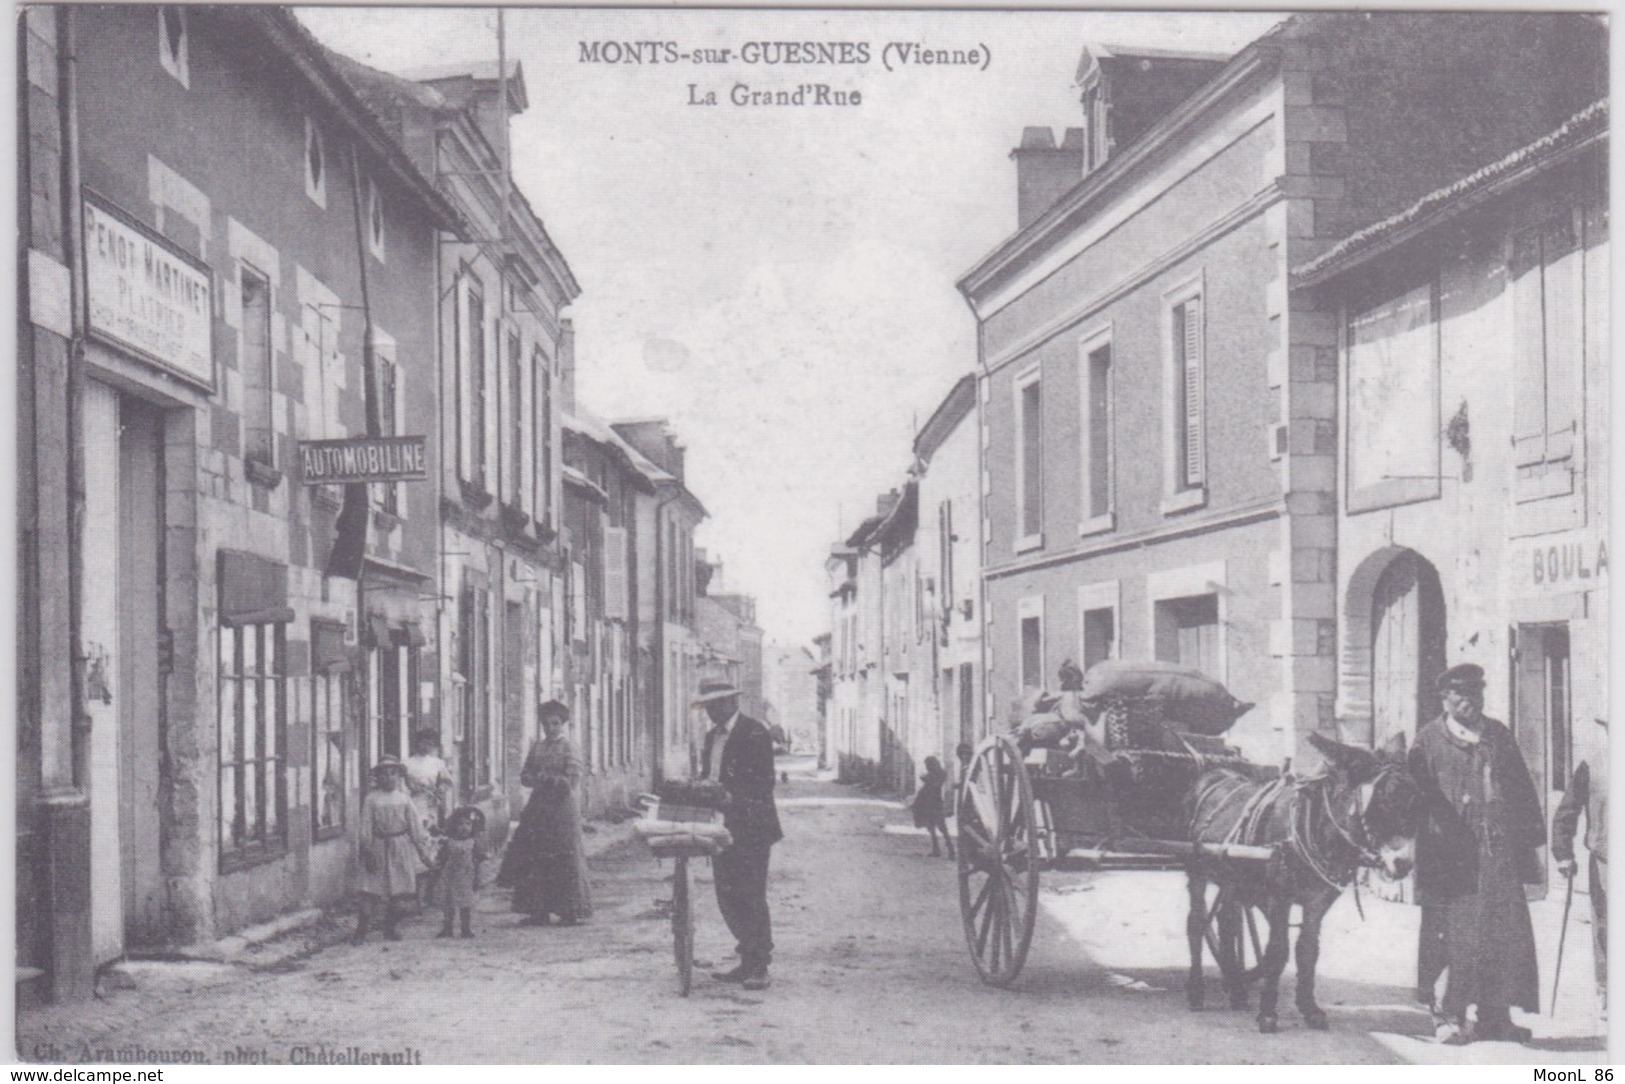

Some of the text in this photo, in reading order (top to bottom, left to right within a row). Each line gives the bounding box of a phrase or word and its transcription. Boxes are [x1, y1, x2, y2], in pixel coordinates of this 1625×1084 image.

[84, 204, 209, 315] PENOT MARTINET
[304, 443, 424, 476] AUTOMOBILINE
